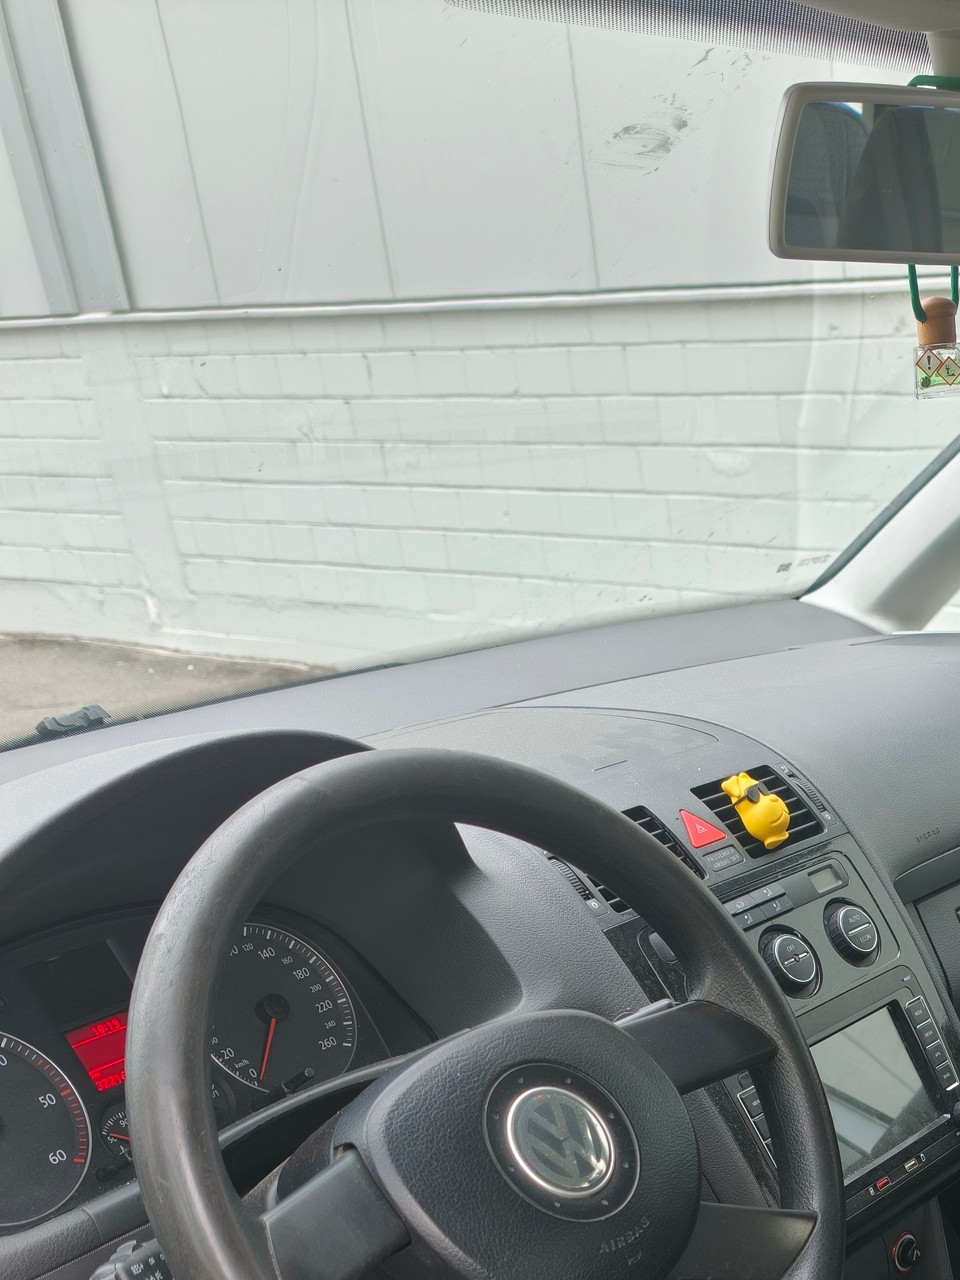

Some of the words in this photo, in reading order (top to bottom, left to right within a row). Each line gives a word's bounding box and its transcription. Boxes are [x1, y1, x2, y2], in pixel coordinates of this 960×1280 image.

[848, 914, 861, 924] AUTO
[859, 933, 872, 943] ECON
[241, 942, 254, 953] 120
[786, 944, 796, 953] OFF
[257, 946, 276, 961] 140
[280, 955, 294, 966] 160
[292, 967, 310, 981] 180
[309, 983, 322, 993] 200
[315, 999, 333, 1014] 220
[324, 1019, 337, 1030] 240
[318, 1036, 337, 1051] 260
[220, 1047, 235, 1060] 20
[234, 1058, 250, 1069] km/h
[248, 1067, 258, 1078] 0
[38, 1093, 56, 1108] 50
[48, 1149, 67, 1165] 60
[599, 1215, 651, 1254] AIRBAG
